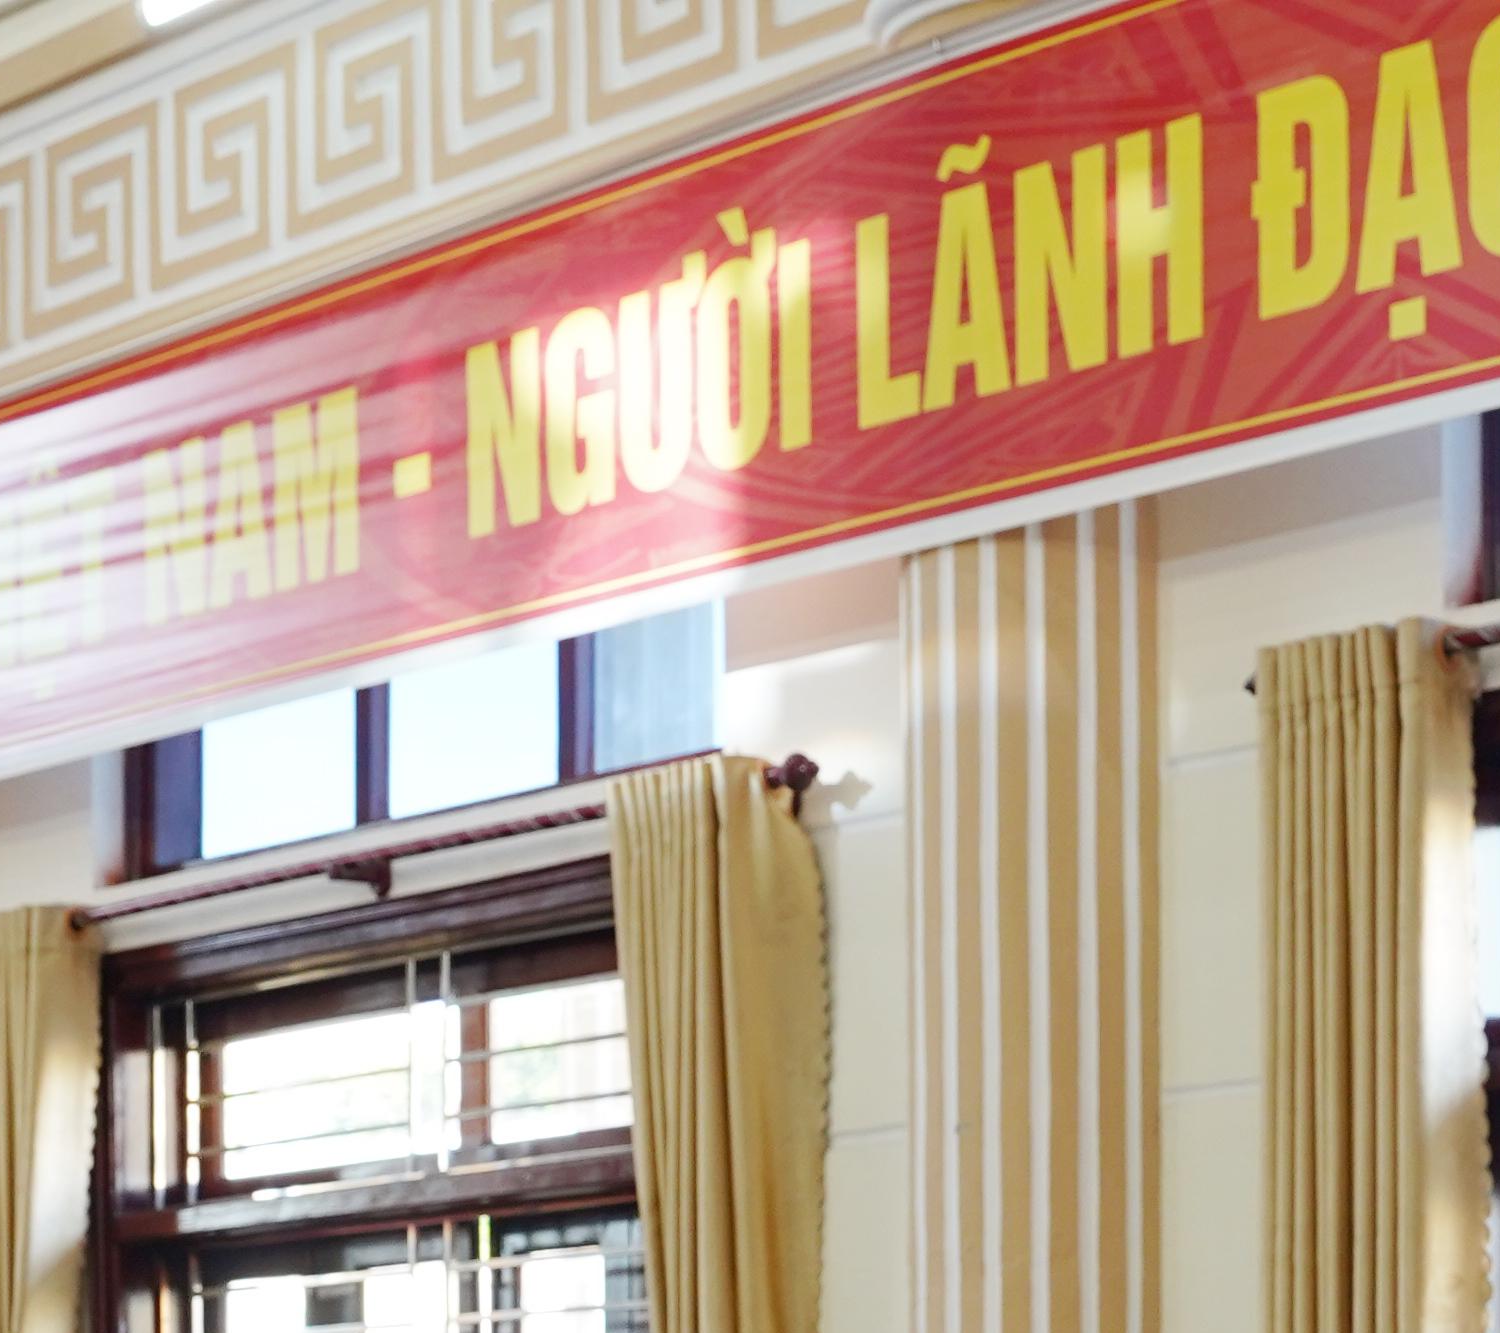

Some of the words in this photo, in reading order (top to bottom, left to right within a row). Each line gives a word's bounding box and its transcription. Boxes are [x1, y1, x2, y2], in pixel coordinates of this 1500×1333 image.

[143, 386, 359, 627] NAM
[465, 206, 812, 539] NGƯỜI
[855, 111, 1204, 430] LÃNH
